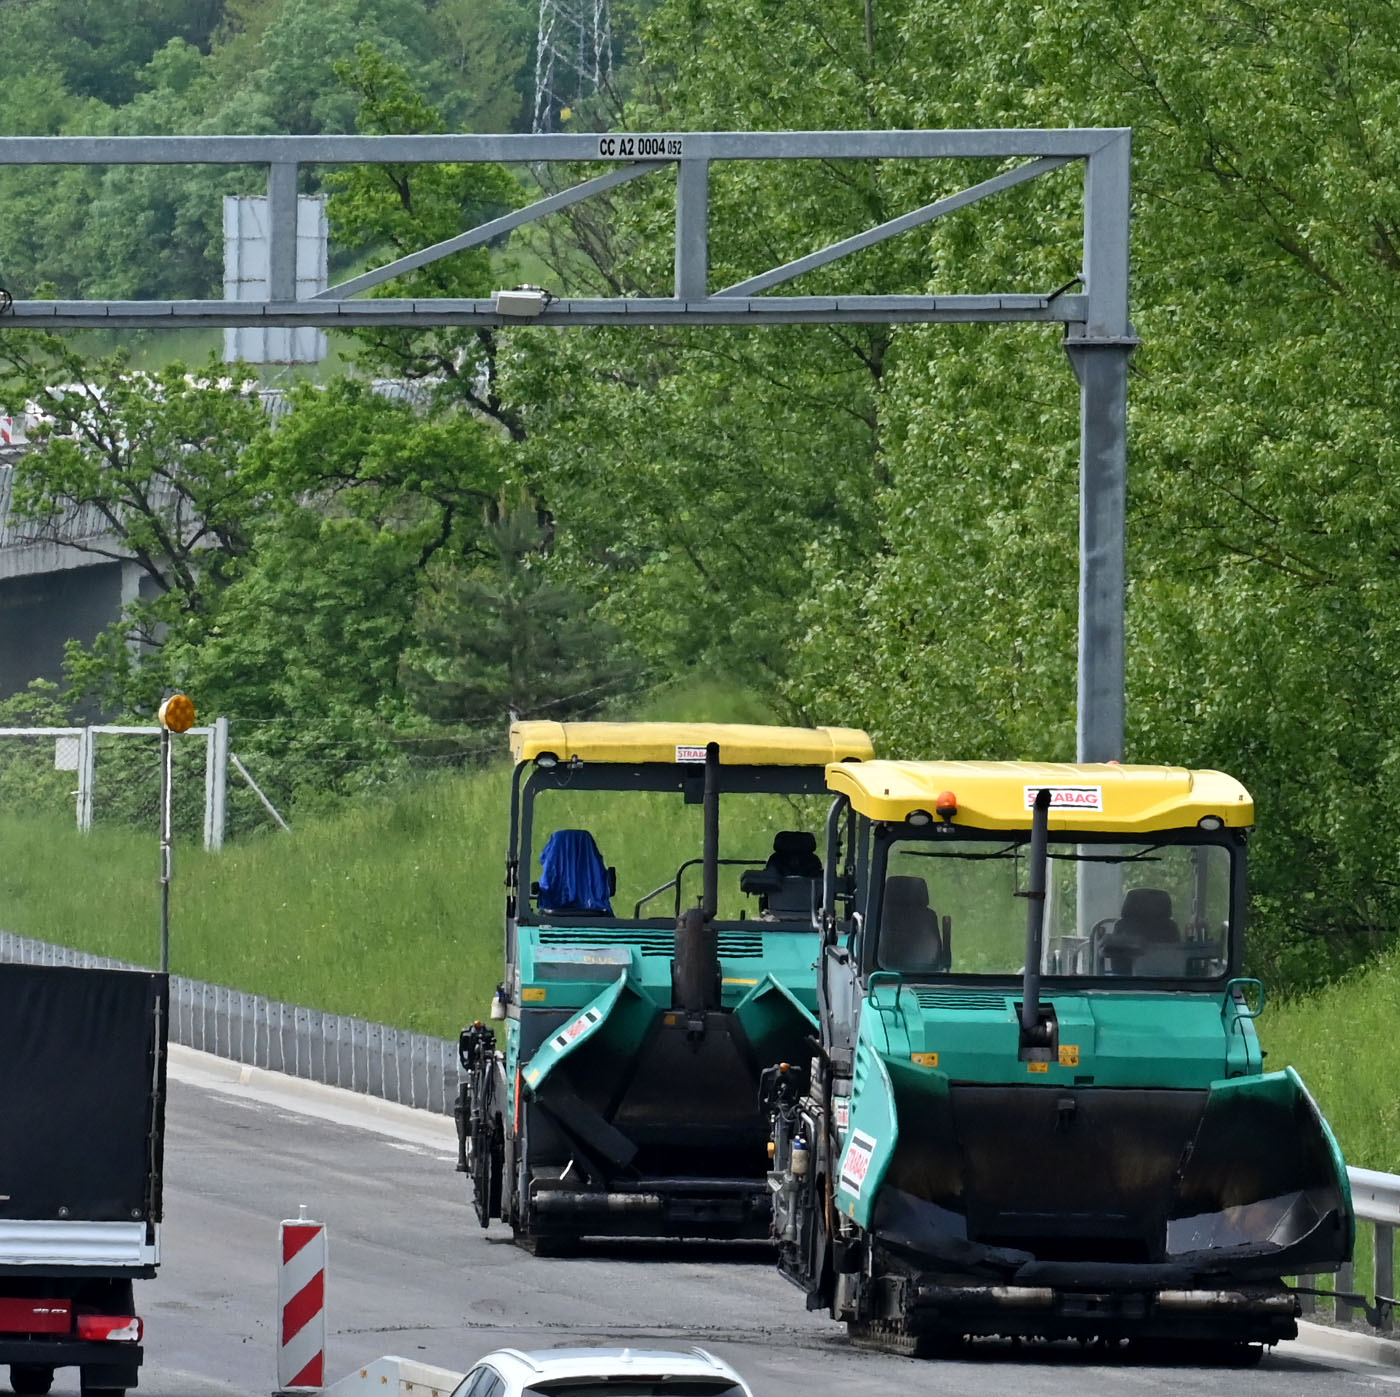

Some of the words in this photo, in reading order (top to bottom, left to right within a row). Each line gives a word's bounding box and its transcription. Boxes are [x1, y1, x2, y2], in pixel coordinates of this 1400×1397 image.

[600, 138, 615, 156] CC
[619, 138, 634, 155] A2
[638, 138, 665, 155] 0004
[668, 140, 682, 154] 052
[1027, 793, 1099, 803] SABAG
